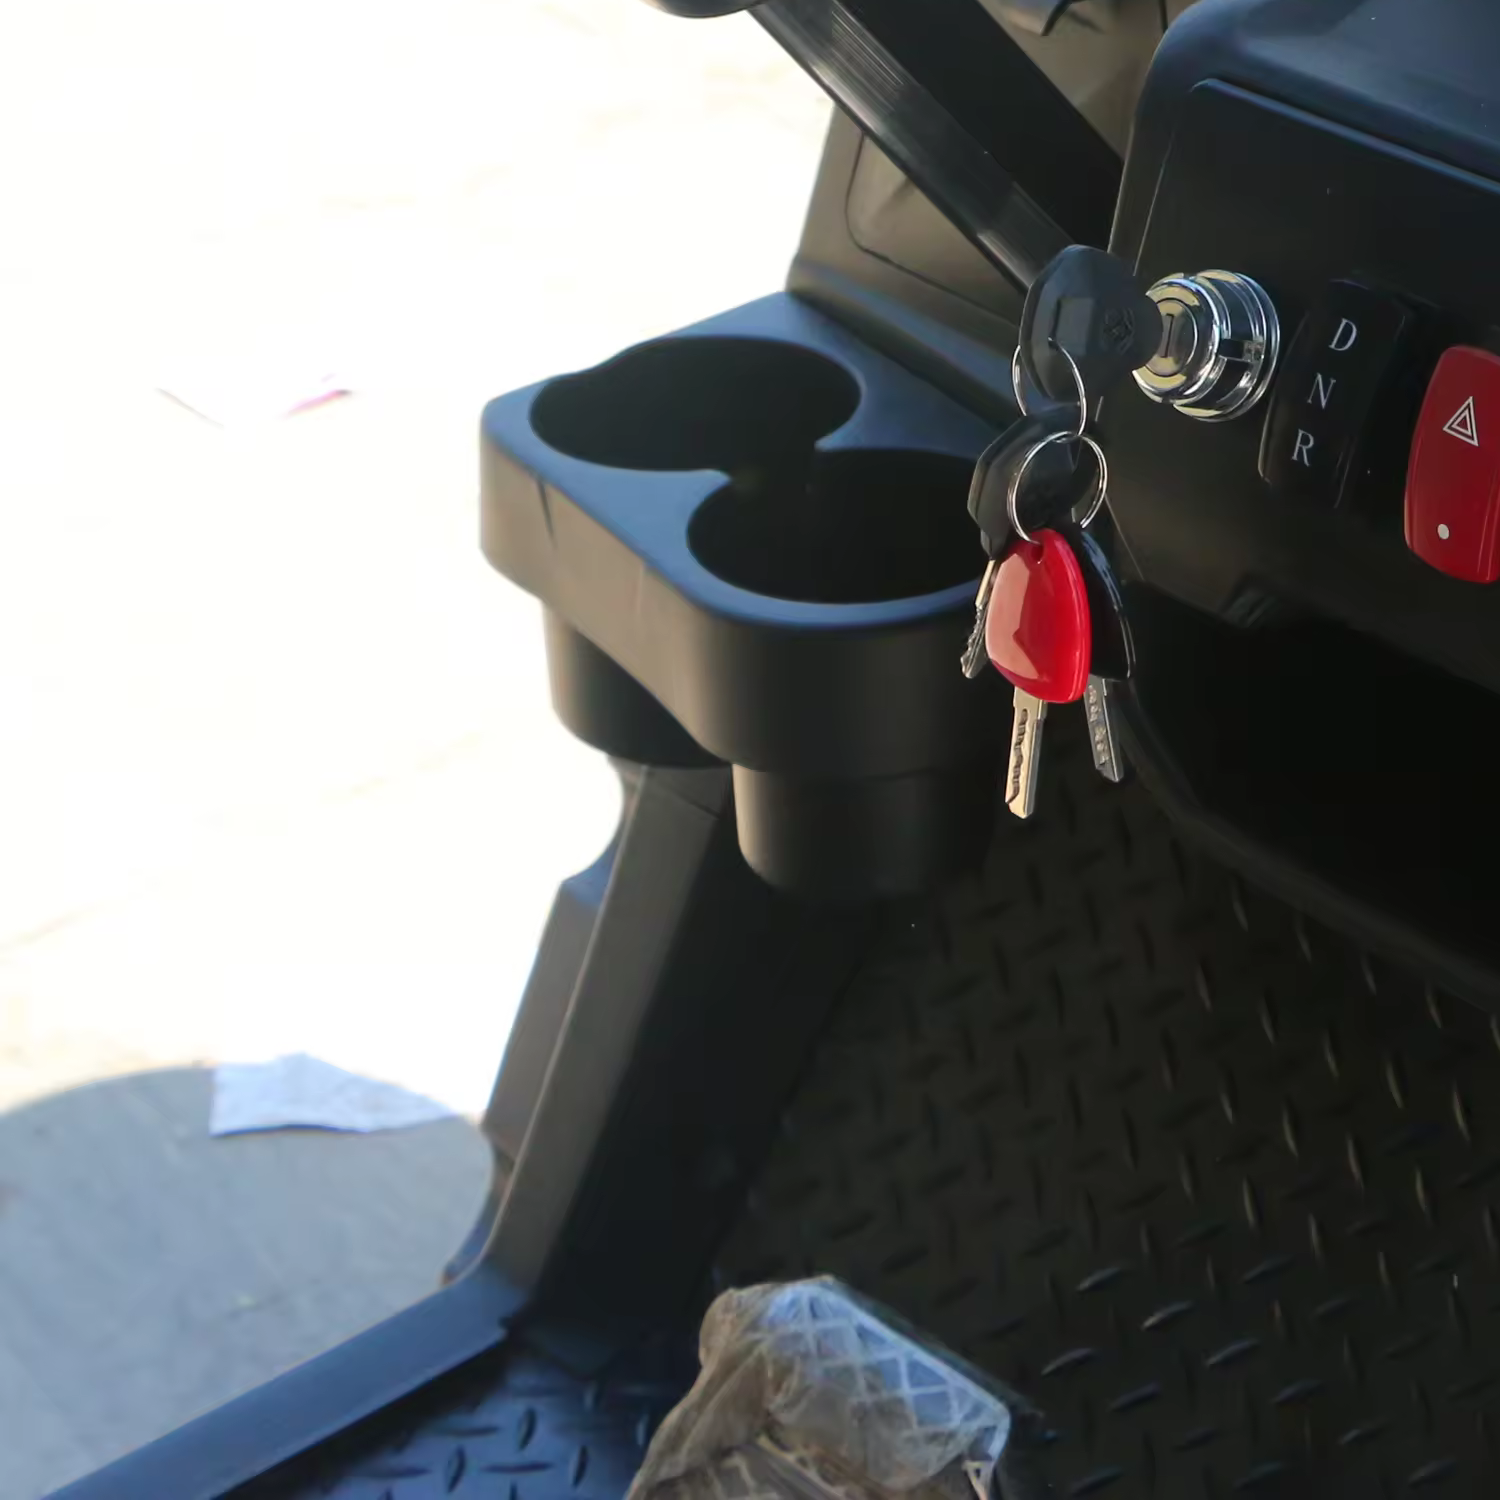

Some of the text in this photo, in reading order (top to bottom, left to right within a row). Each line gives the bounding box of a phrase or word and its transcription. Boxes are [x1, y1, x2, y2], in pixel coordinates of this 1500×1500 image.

[1328, 317, 1358, 352] D
[1306, 371, 1337, 410] N
[1291, 428, 1315, 468] R
